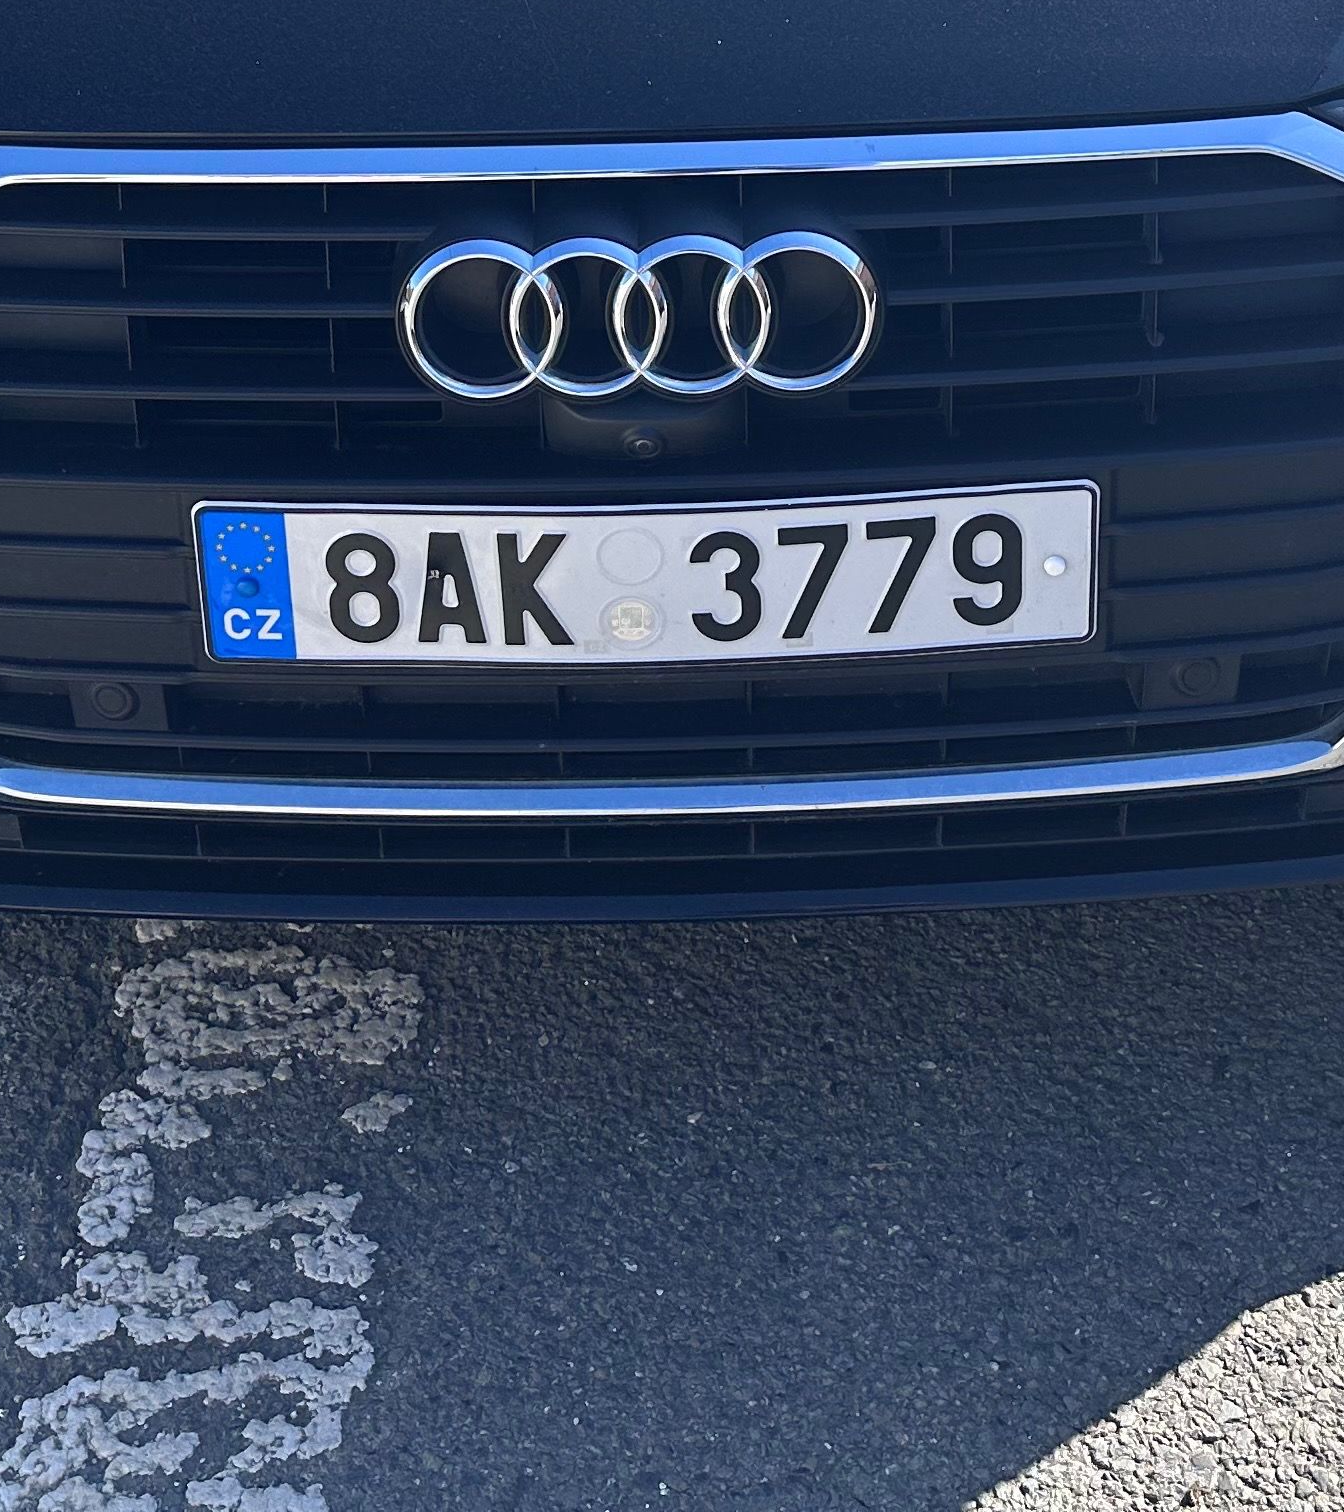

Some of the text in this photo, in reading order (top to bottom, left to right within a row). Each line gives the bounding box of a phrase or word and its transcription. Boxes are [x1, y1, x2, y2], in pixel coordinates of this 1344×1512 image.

[326, 513, 1023, 645] 8AK 3779
[224, 608, 282, 639] CZ
